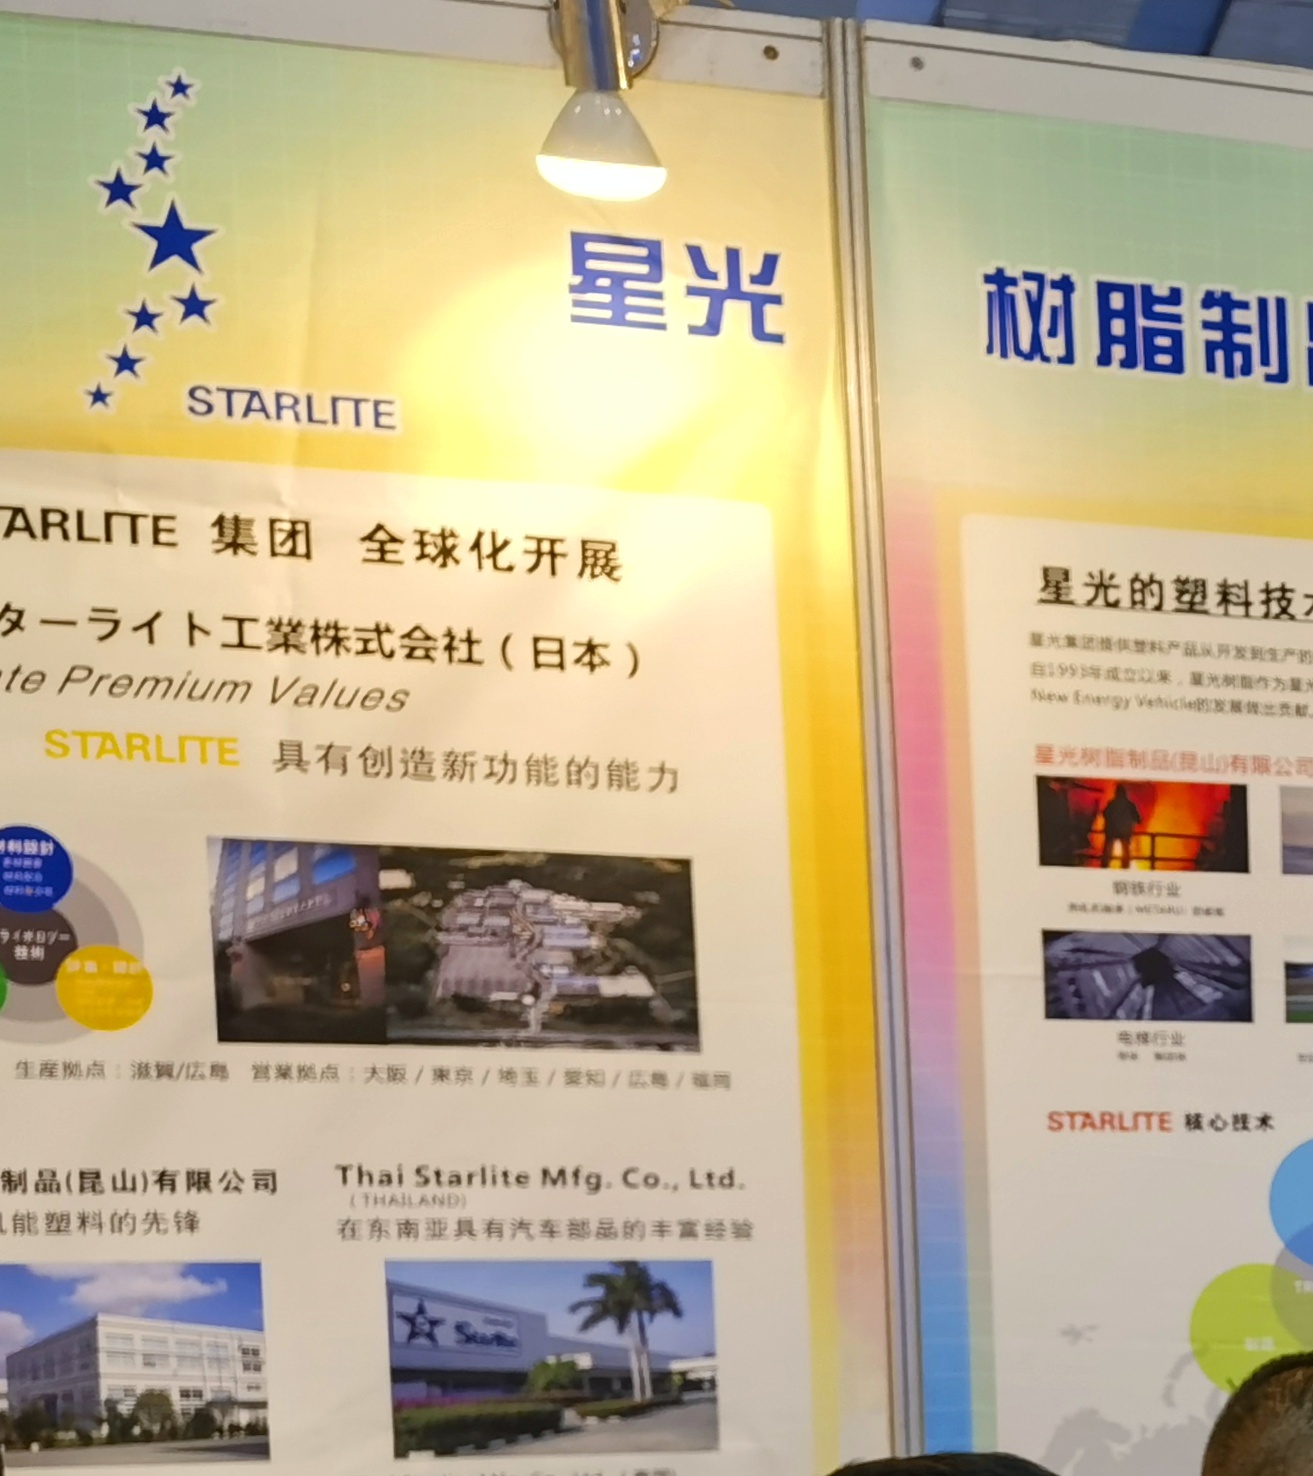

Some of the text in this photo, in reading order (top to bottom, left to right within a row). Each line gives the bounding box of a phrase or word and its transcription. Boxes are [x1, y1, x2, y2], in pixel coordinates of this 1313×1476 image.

[568, 230, 786, 345] 星光
[187, 385, 398, 431] STARLITE
[211, 511, 312, 560] 集团
[359, 521, 624, 584] 全球化开展
[57, 663, 253, 704] Premium
[270, 675, 411, 714] Values
[1030, 687, 1069, 703] New
[1073, 689, 1130, 712] Energy
[43, 728, 680, 794] STARLITE 具有创造新功能的能力
[1047, 1110, 1276, 1134] STARLITE 核心技术
[0, 1167, 278, 1196] 制品(昆山)有限公司
[334, 1163, 747, 1195] Thai Starlite Mfg. Co., Ltd.
